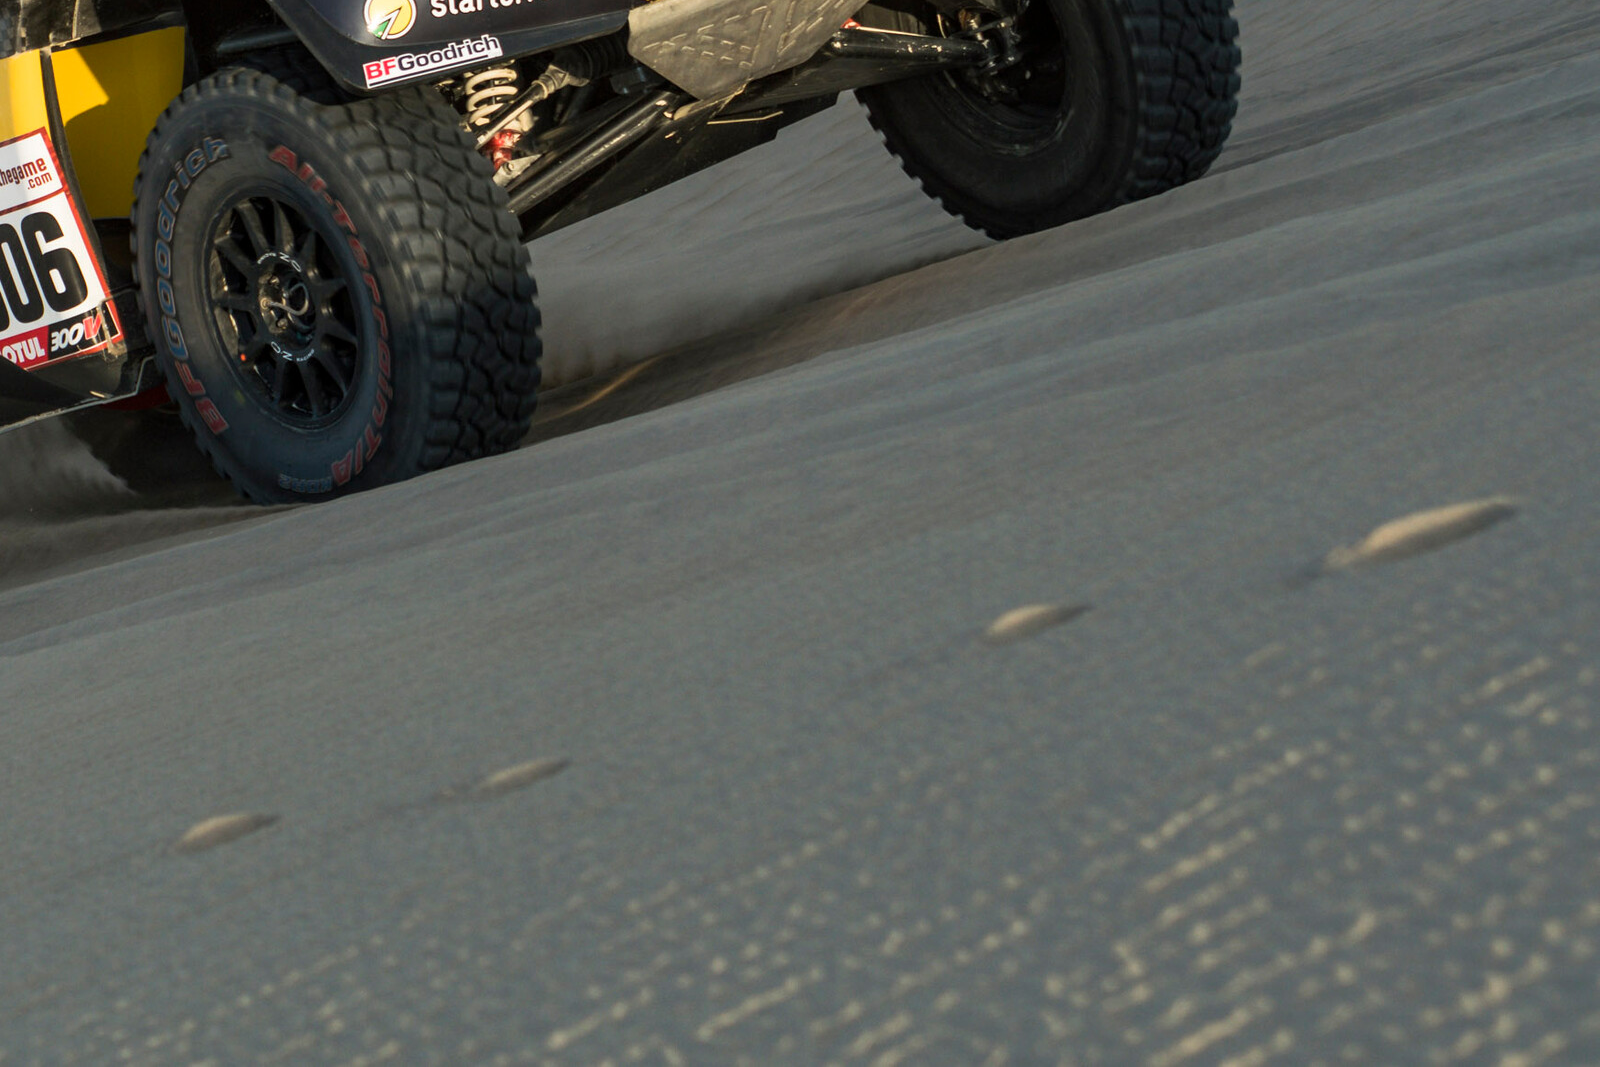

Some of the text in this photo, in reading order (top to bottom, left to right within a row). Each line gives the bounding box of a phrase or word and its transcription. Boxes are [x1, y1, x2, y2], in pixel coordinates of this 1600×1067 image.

[365, 36, 500, 80] BFGoodrich
[27, 172, 53, 190] .com
[155, 135, 230, 434] BFGoodrich
[50, 312, 103, 353] 300V
